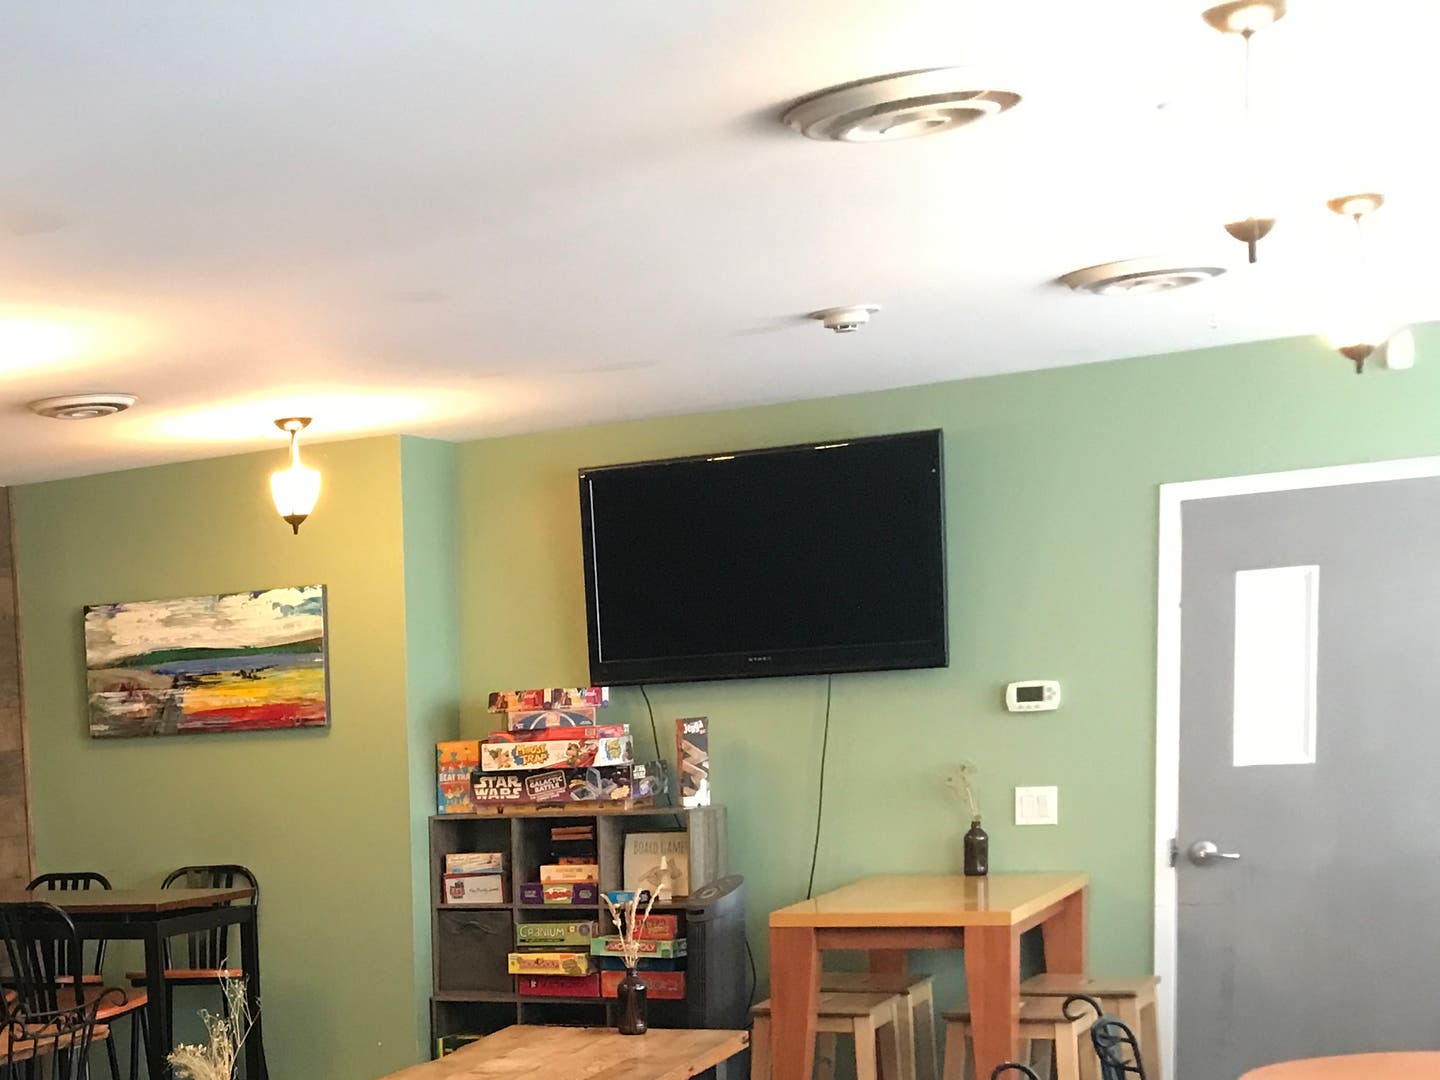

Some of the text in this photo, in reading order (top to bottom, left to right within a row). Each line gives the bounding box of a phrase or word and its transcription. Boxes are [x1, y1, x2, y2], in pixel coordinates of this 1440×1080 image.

[515, 743, 547, 755] MOUSE
[521, 753, 547, 766] TRAP
[474, 776, 522, 788] STAR
[529, 775, 563, 788] GALACTIC
[534, 782, 560, 793] BATTLE
[474, 788, 522, 800] WARS
